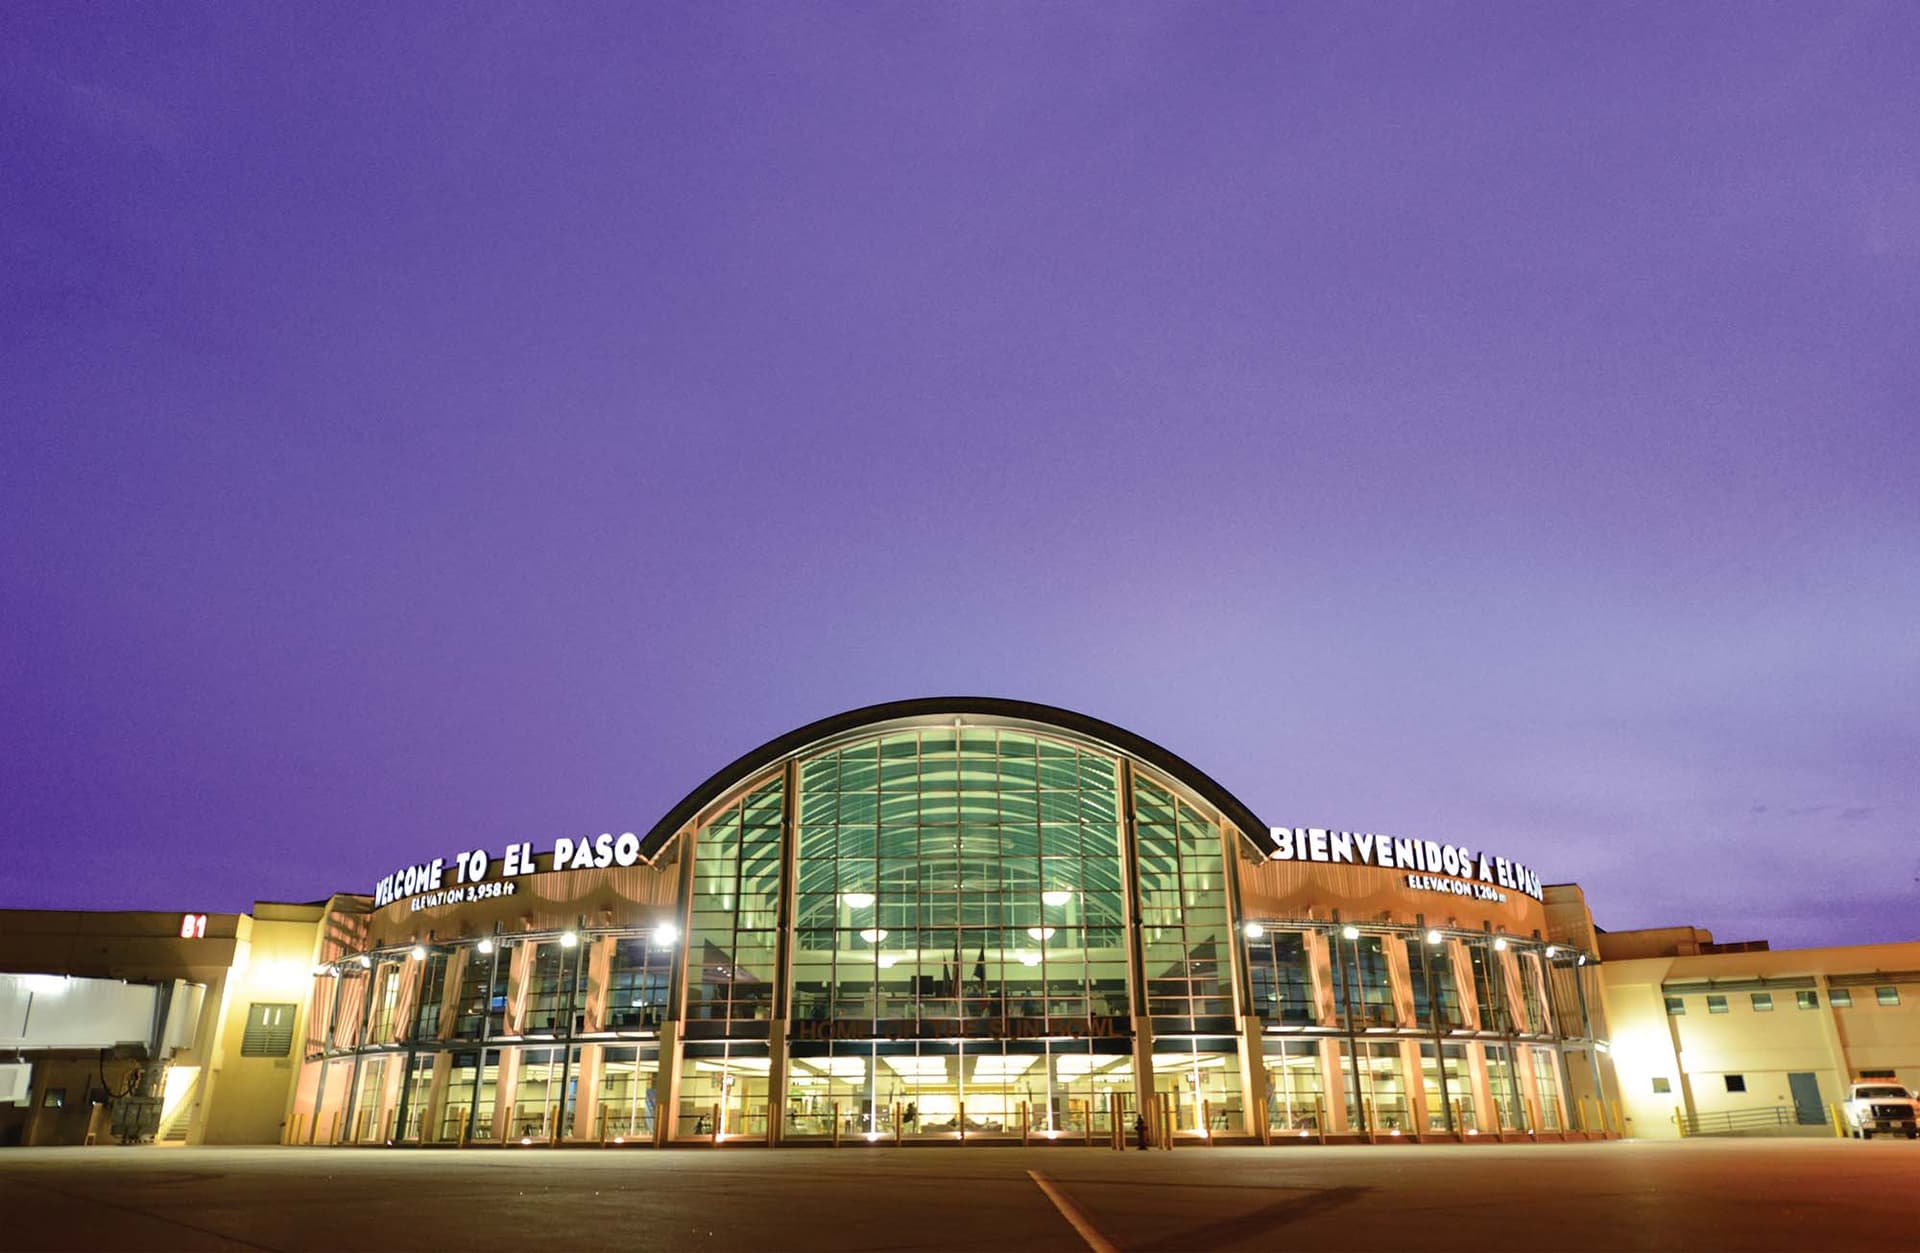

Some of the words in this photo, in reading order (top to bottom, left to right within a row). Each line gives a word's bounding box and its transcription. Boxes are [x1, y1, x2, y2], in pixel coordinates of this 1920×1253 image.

[374, 858, 443, 908] WELCOME
[456, 849, 488, 884] TO
[503, 842, 535, 877] EL
[553, 832, 640, 871] PASO
[1270, 827, 1473, 879] BIENVENIDOS
[1479, 852, 1494, 883] A
[1496, 856, 1517, 889] EL
[411, 888, 464, 911] ELEVATION
[466, 882, 501, 902] 3,958
[503, 881, 514, 896] ft
[1408, 874, 1472, 897] ELEVACION
